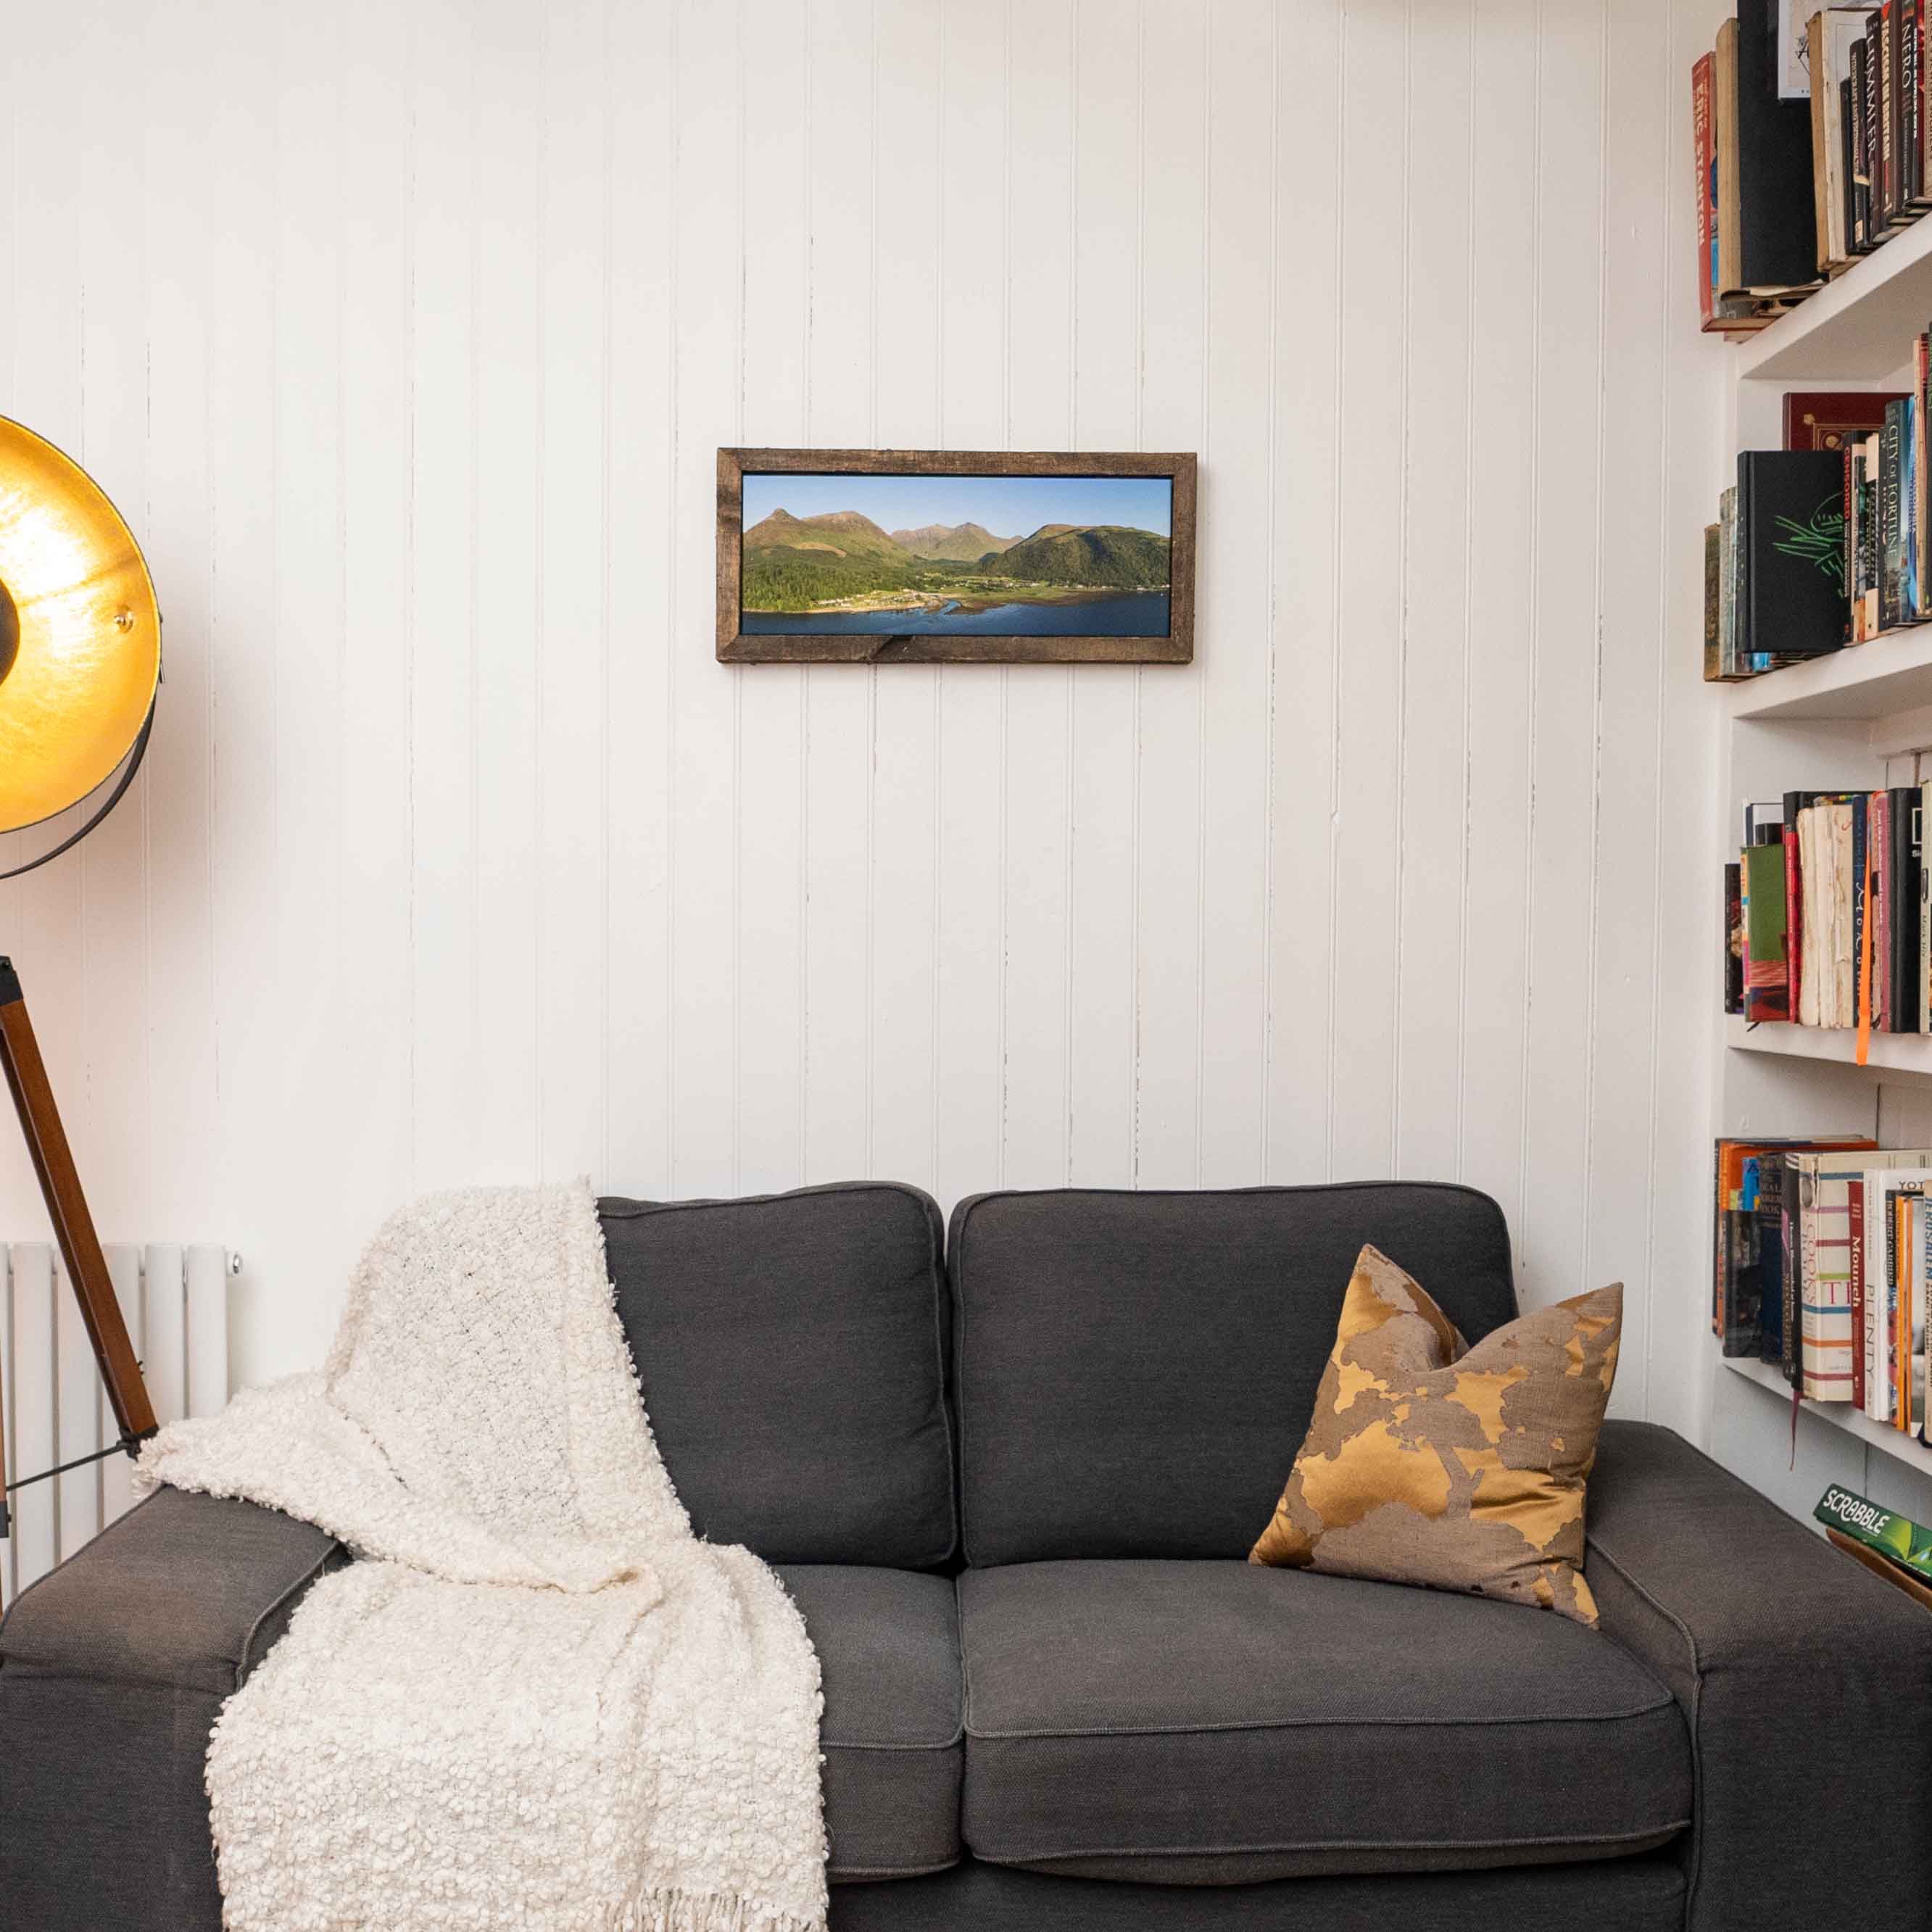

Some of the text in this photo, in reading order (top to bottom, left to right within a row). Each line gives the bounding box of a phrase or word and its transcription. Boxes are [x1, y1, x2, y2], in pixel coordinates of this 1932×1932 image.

[1902, 24, 1911, 88] NERO
[1866, 35, 1876, 159] HIMMLER
[1882, 83, 1889, 100] IN
[1696, 81, 1705, 246] ERIC STANTON
[1889, 425, 1898, 460] CITY
[1888, 484, 1898, 557] FORTUNE
[1898, 1181, 1924, 1190] YOT
[1852, 1236, 1861, 1307] Mouneh
[1823, 1489, 1891, 1534] SCRABBLE
